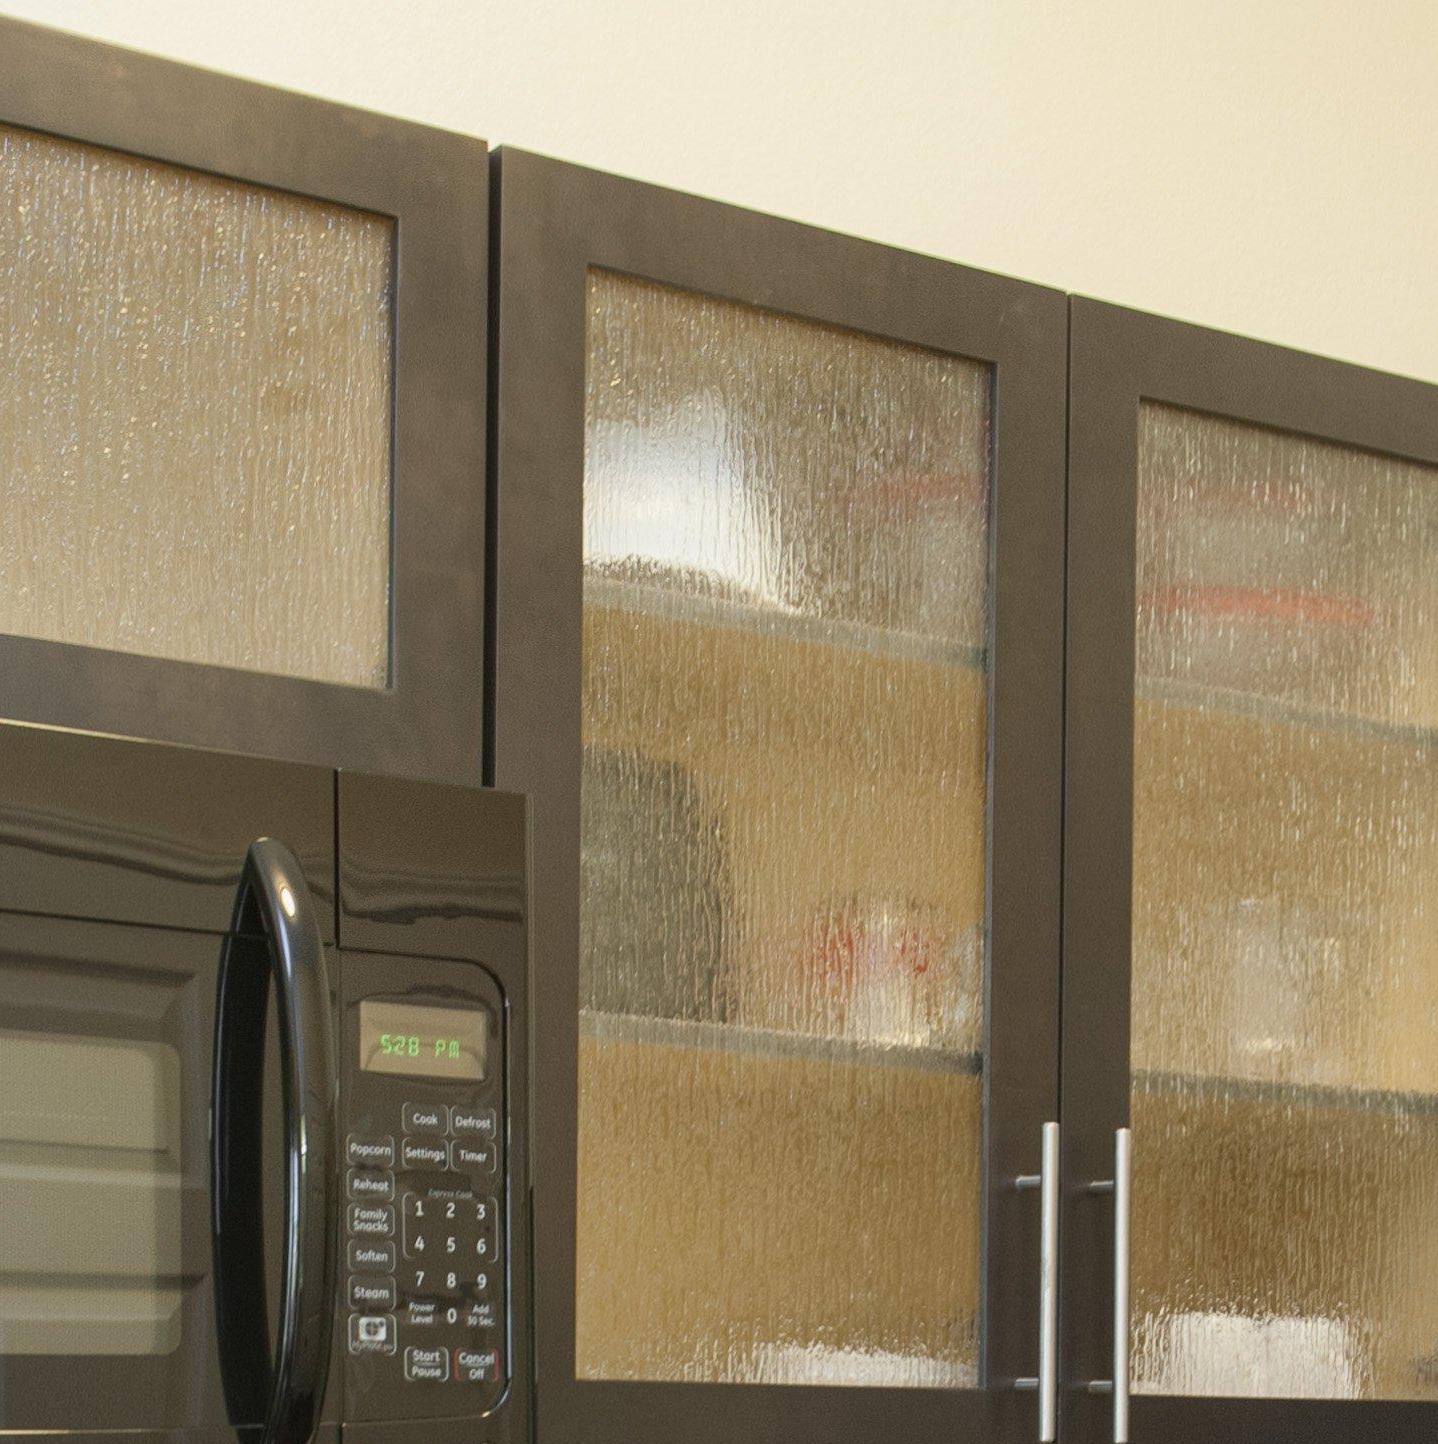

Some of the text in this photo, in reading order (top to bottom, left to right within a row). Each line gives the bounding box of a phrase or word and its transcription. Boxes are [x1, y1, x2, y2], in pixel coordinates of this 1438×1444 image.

[435, 1039, 460, 1059] PM
[413, 1112, 438, 1125] Cook
[455, 1115, 491, 1130] Defrost
[350, 1142, 392, 1156] Popcorn
[406, 1147, 445, 1162] Settings
[460, 1150, 487, 1163] Timer
[353, 1179, 390, 1192] Reheat
[354, 1208, 388, 1221] Family
[415, 1200, 486, 1220] 1 2 3
[353, 1221, 389, 1232] Snacks
[415, 1235, 486, 1255] 4 5 6
[355, 1250, 388, 1262] Soften
[415, 1271, 487, 1290] 7 8 9
[354, 1286, 390, 1300] Steam
[409, 1302, 435, 1313] Power
[472, 1304, 490, 1314] Add
[411, 1314, 434, 1325] Level
[447, 1308, 457, 1324] 0
[413, 1349, 440, 1362] Start
[459, 1352, 495, 1365] Cancel
[412, 1365, 441, 1377] Pause
[469, 1368, 485, 1380] Off
